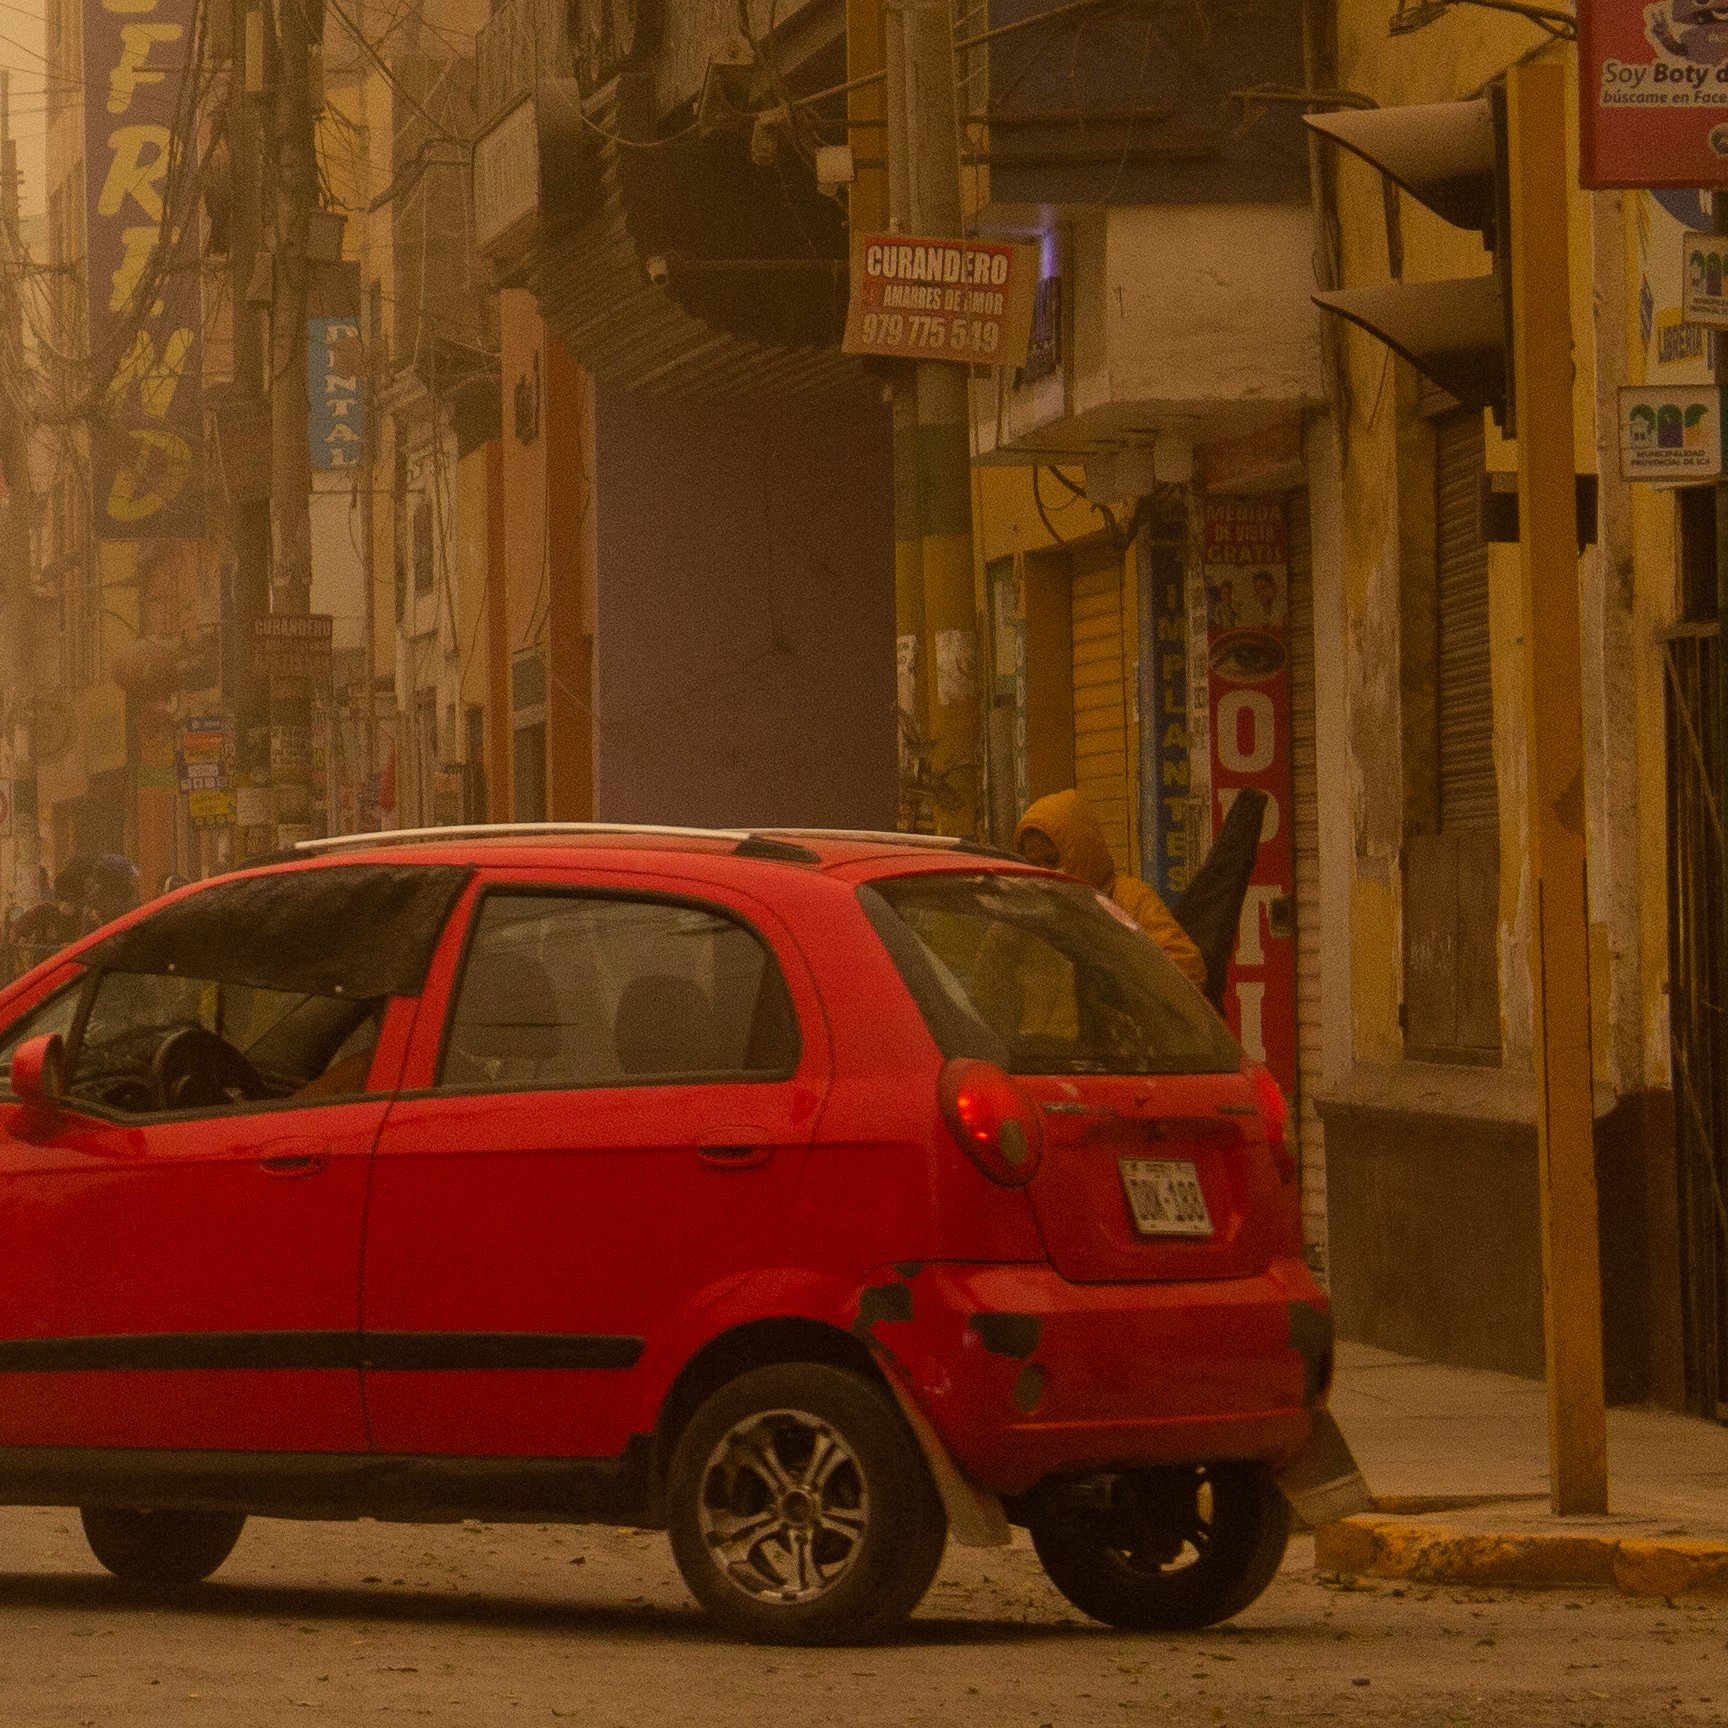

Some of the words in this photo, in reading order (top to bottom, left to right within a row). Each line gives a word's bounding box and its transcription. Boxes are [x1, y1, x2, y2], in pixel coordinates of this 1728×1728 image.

[1604, 61, 1648, 90] Soy
[1653, 62, 1710, 90] Boty
[1603, 89, 1667, 104] búscame
[1672, 92, 1689, 104] en
[867, 245, 1009, 285] CURANDERO
[883, 285, 943, 310] AMARRES
[944, 287, 962, 312] DE
[964, 290, 1004, 316] AMOR
[862, 313, 904, 346] 979
[908, 315, 946, 349] 775
[950, 318, 1000, 353] 549
[1630, 458, 1681, 467] PROVINCIAL
[1635, 449, 1706, 458] MUNICIPALIDAD
[1206, 504, 1282, 522] MEDIDA
[1214, 524, 1232, 541] DE
[1236, 524, 1275, 542] VISTA
[1207, 544, 1282, 563] GRATIS
[1157, 584, 1190, 893] IMPLANTES
